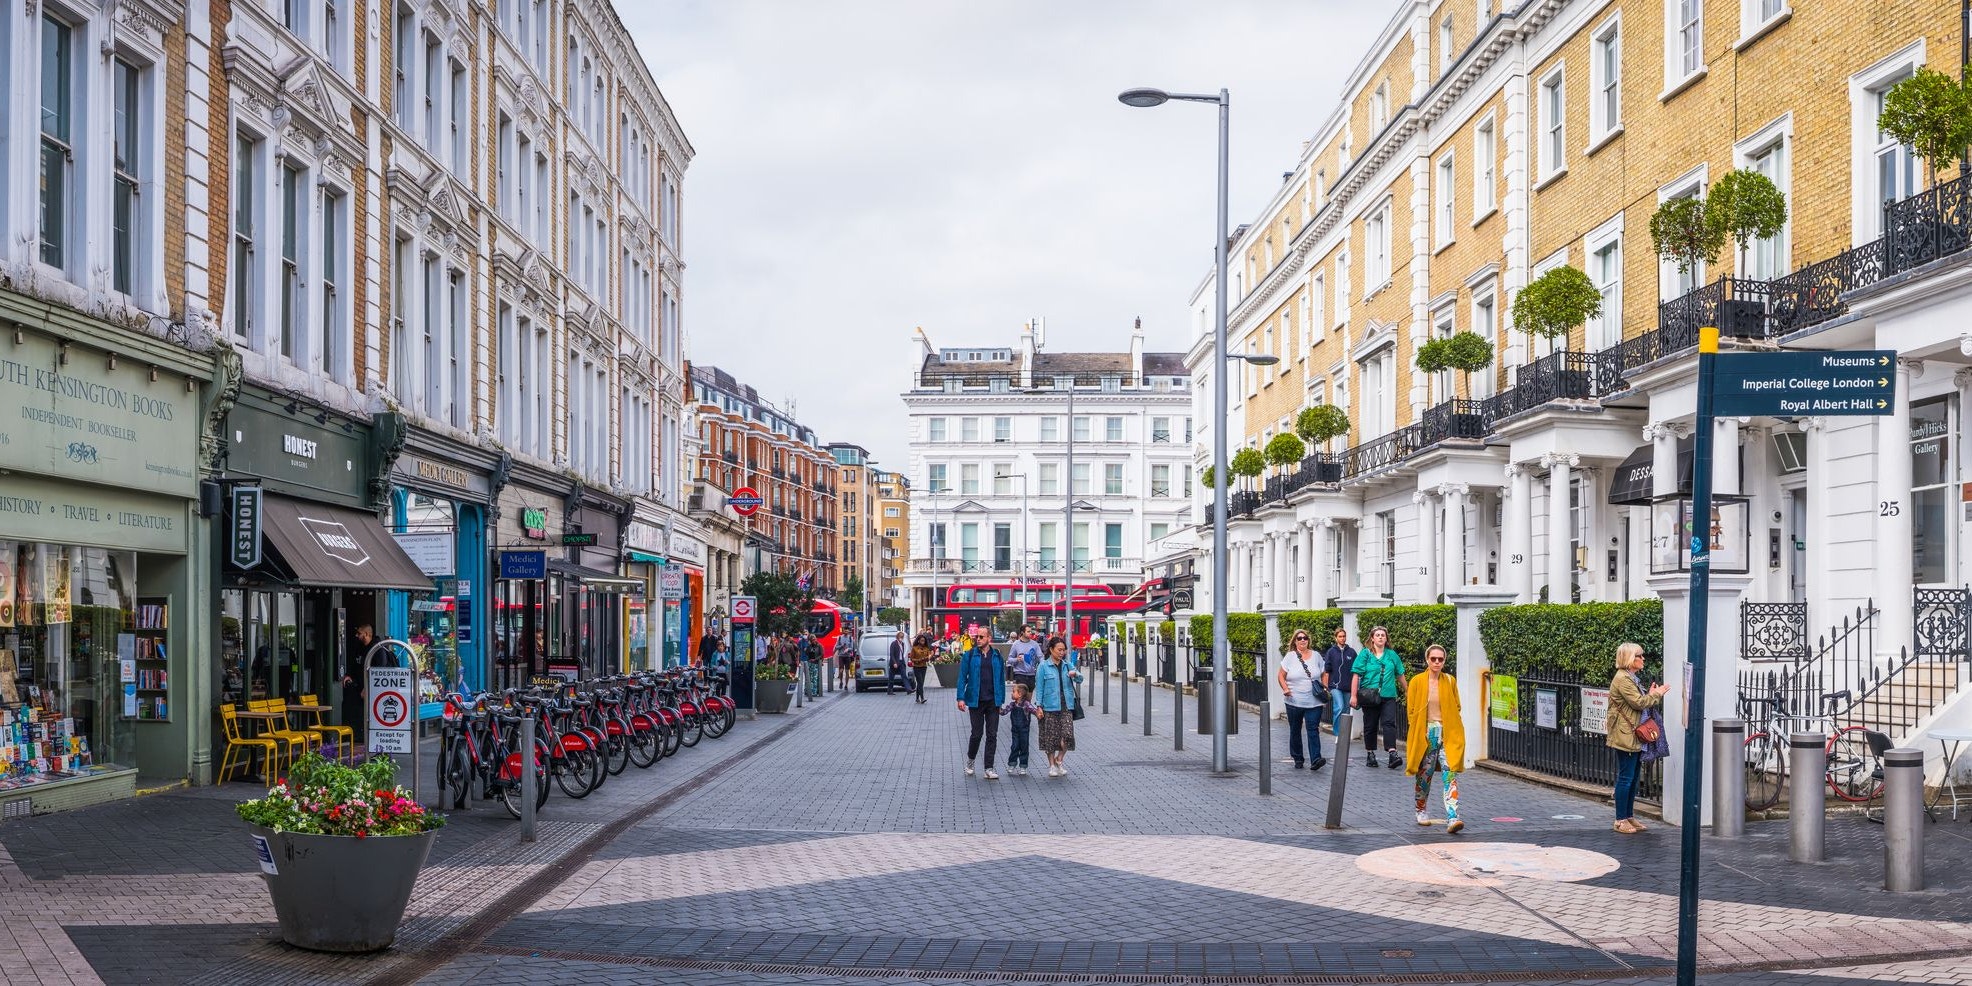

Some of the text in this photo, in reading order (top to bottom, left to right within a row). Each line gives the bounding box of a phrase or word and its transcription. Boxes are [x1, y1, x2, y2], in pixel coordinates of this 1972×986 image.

[1822, 356, 1875, 366] Museums
[1742, 378, 1874, 390] Imperial College London
[0, 360, 173, 421] UTH KENSINGTON BOOKS
[1781, 399, 1873, 411] Royal Albert Hall
[21, 406, 136, 443] INDEPENDENT BOOKSELLER
[1929, 422, 1947, 434] Hicks
[284, 434, 317, 459] HONEST
[1915, 443, 1939, 454] Gallery
[1630, 466, 1654, 481] DESSA
[0, 496, 173, 531] HISTORY TRAVEL LITERATURE
[1880, 501, 1899, 516] 25
[239, 495, 252, 560] HONEST
[509, 555, 537, 563] Medici
[1511, 553, 1523, 565] 29
[507, 565, 538, 576] Gallery
[1418, 566, 1428, 575] 31
[1018, 577, 1047, 585] NtWest
[374, 678, 406, 688] ZONE
[532, 677, 560, 685] Medici
[1587, 707, 1606, 720] THURLO
[1583, 718, 1600, 730] STREET
